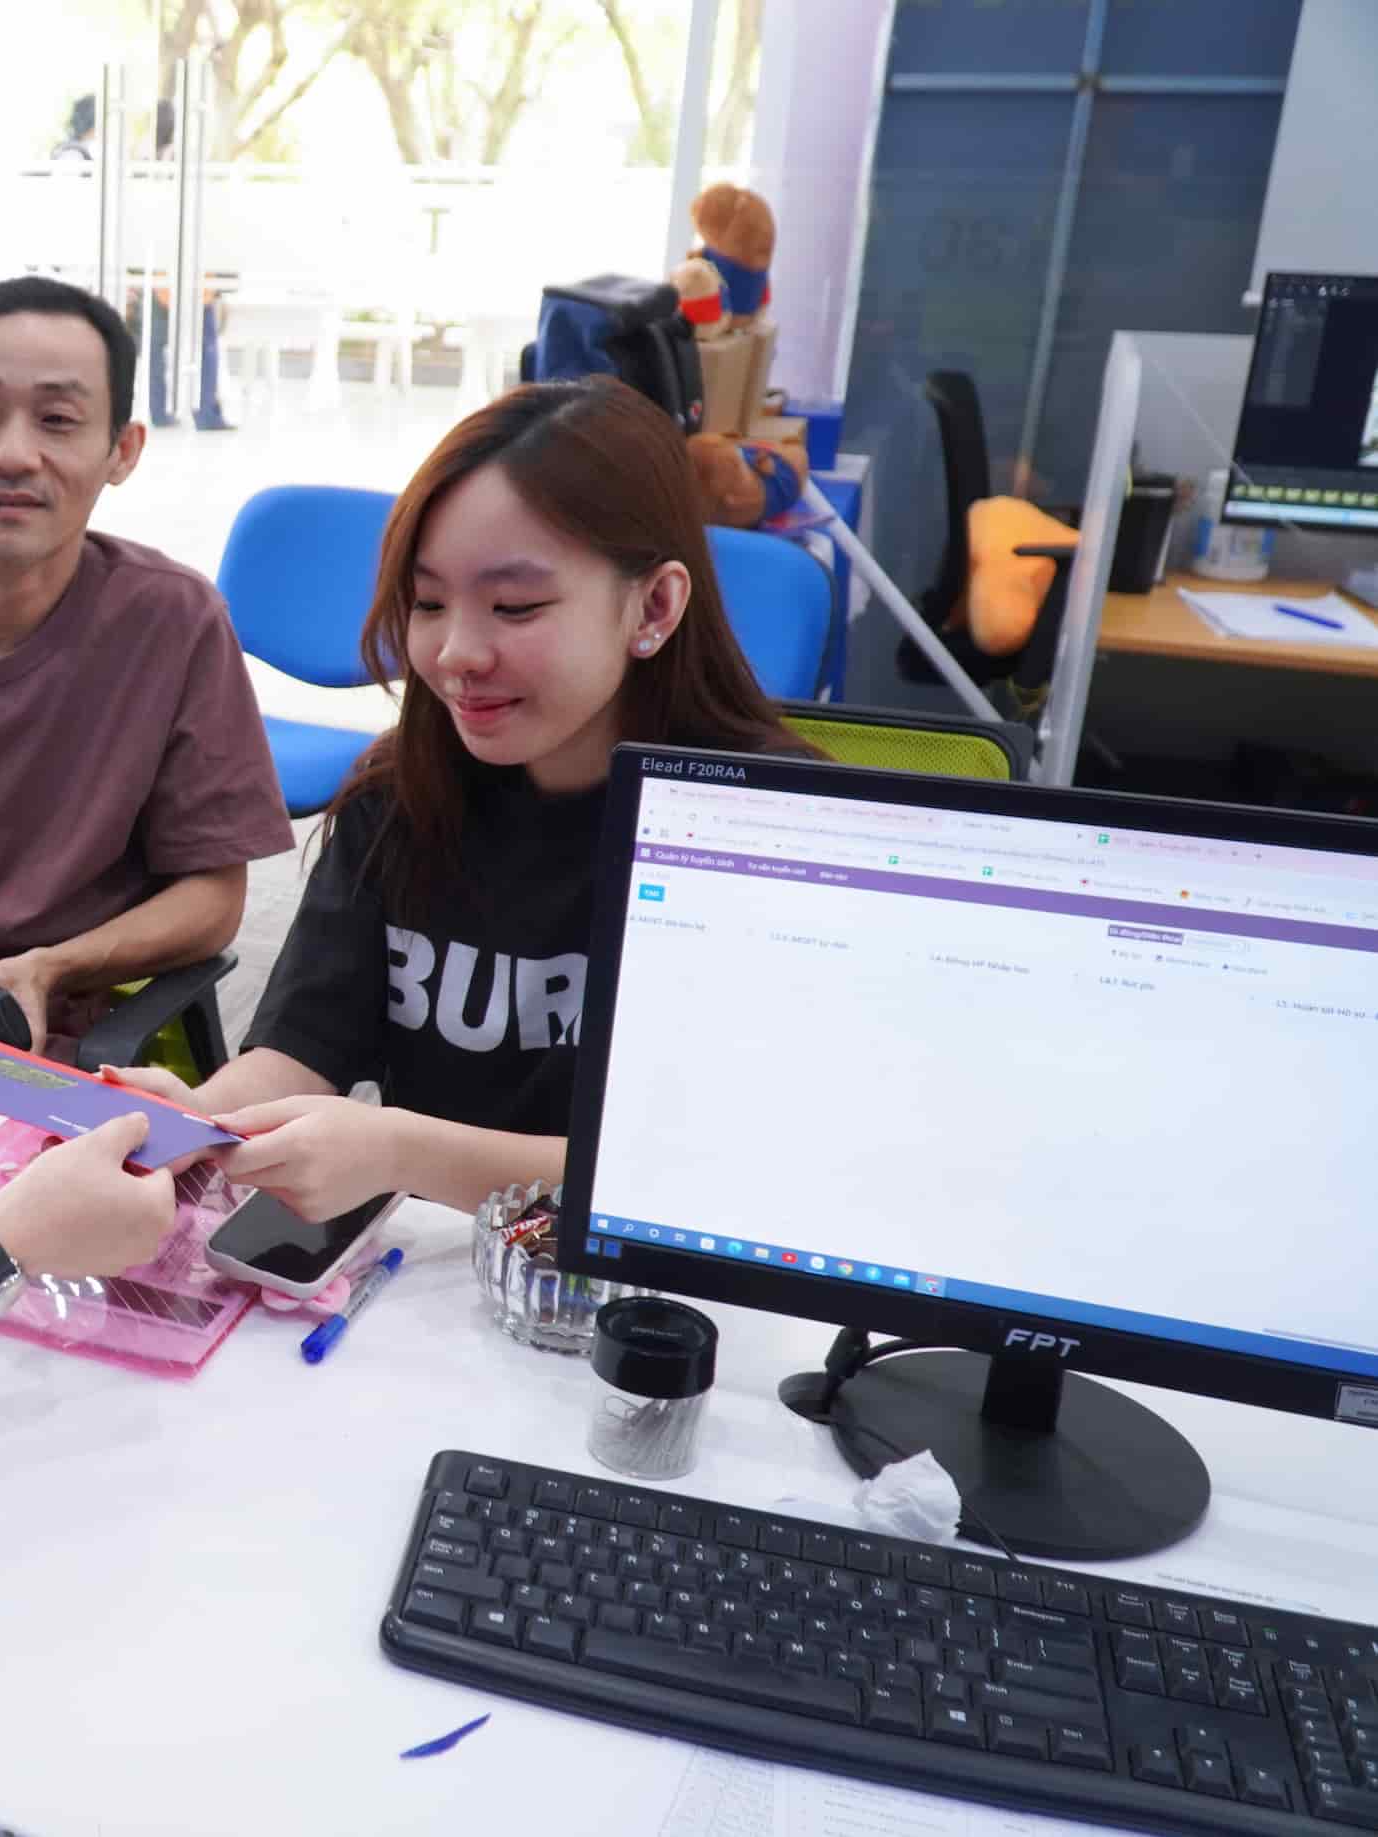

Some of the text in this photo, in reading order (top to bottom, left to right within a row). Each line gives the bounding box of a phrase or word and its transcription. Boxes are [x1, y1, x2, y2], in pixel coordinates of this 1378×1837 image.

[642, 758, 747, 781] Elead F20RAA
[1006, 1328, 1081, 1358] FPT
